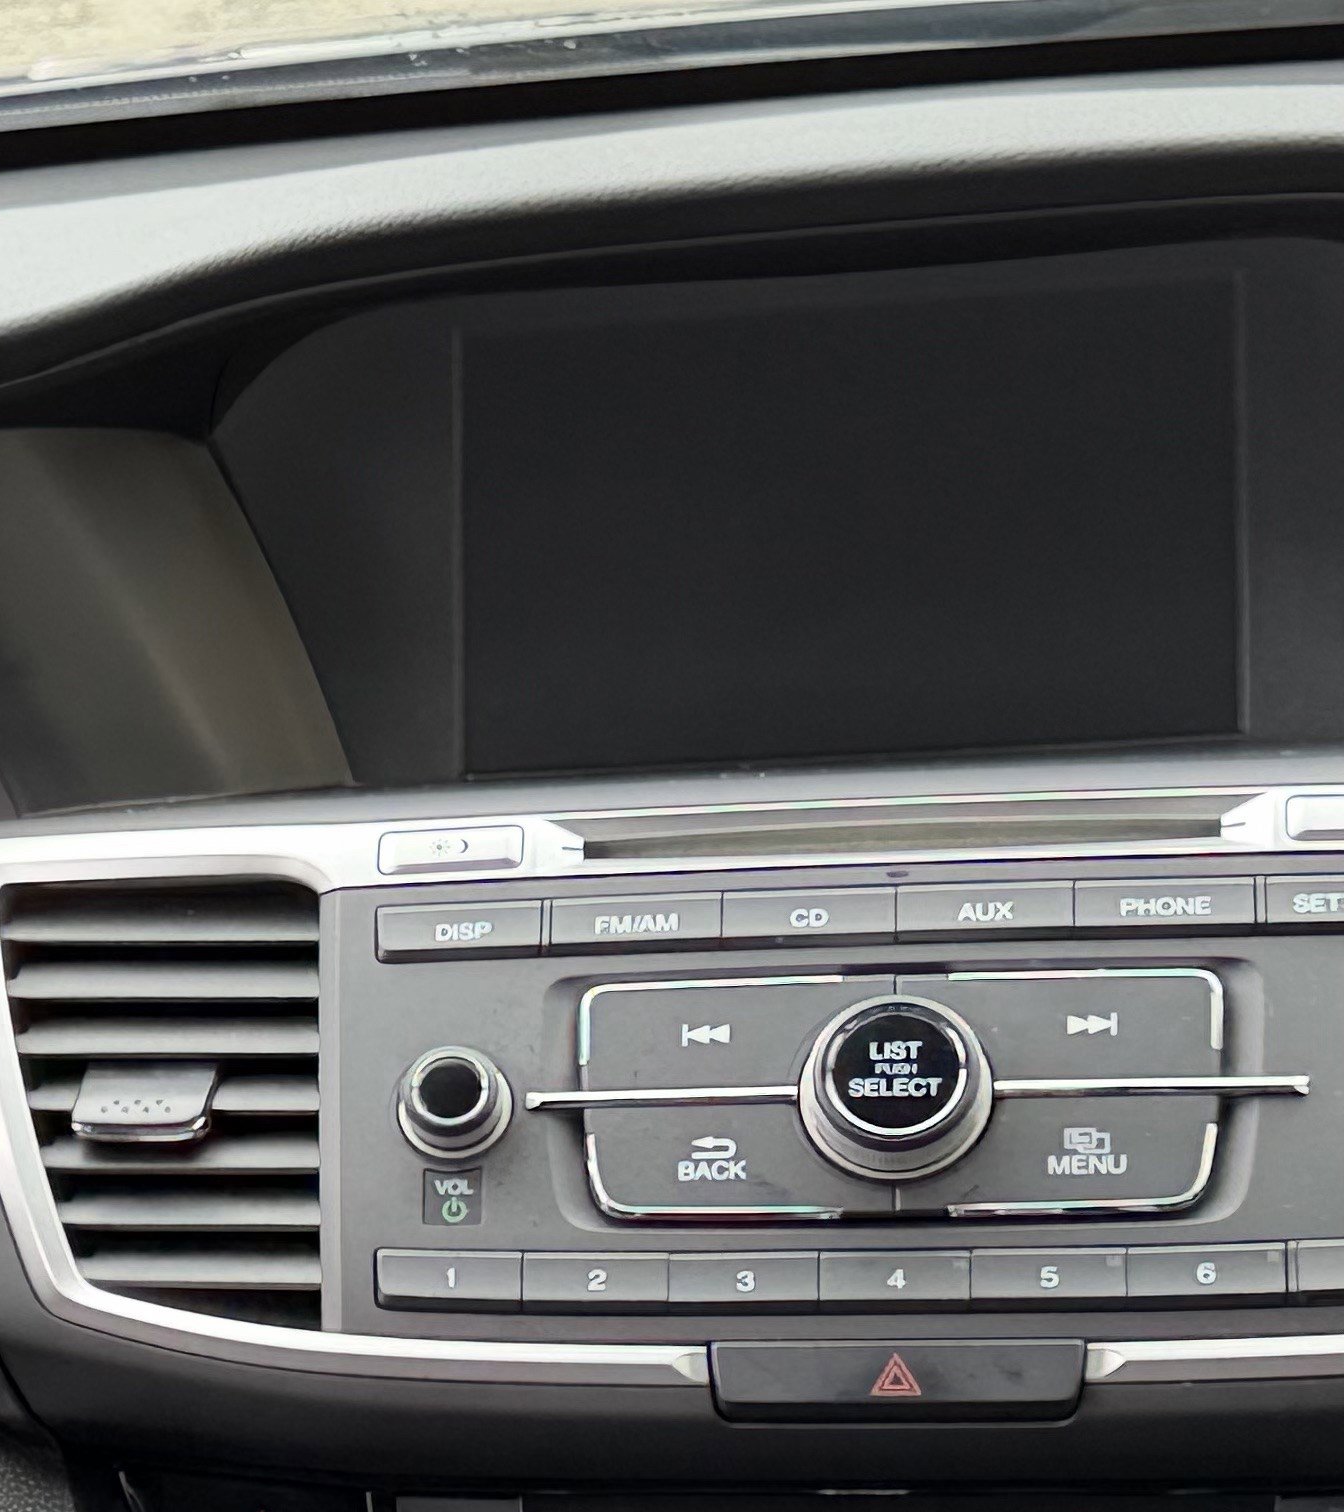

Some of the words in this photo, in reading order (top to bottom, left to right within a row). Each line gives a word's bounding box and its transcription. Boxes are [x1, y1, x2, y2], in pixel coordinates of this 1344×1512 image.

[957, 901, 1015, 922] AUX
[1119, 896, 1212, 917] PHONE
[593, 912, 680, 934] FM/AM
[789, 907, 830, 929] CD
[434, 920, 492, 941] DISP
[868, 1040, 923, 1061] LIST
[847, 1077, 943, 1098] SELECT
[676, 1158, 747, 1182] BACK
[1047, 1153, 1128, 1176] MENU
[433, 1178, 474, 1197] VOL
[444, 1266, 458, 1289] 1
[587, 1268, 608, 1291] 2
[736, 1270, 757, 1292] 3
[886, 1268, 907, 1290] 4
[1040, 1265, 1060, 1289] 5
[1196, 1261, 1217, 1286] 6
